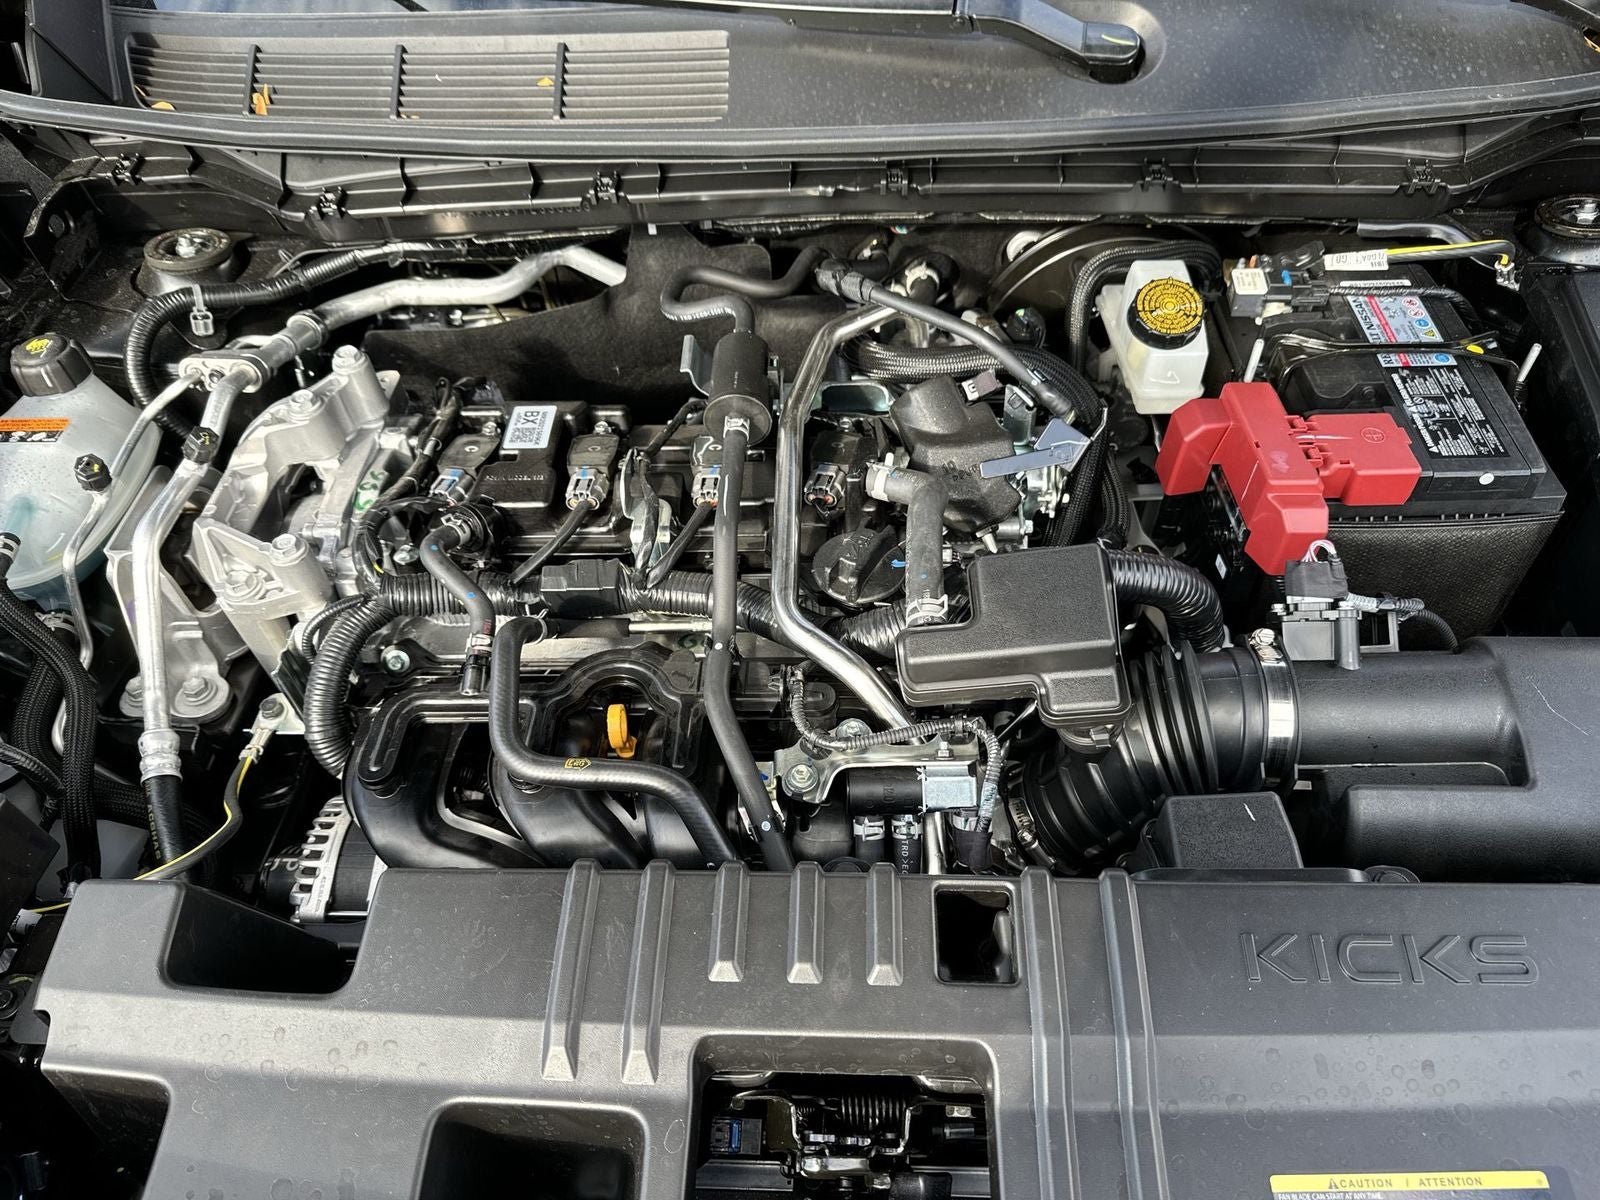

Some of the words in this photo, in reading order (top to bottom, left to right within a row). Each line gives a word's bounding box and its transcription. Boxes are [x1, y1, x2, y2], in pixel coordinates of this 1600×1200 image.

[521, 411, 540, 425] BX
[1240, 934, 1540, 985] KICKS
[1340, 1179, 1393, 1189] CAUTION
[1419, 1177, 1483, 1188] ATTENTION
